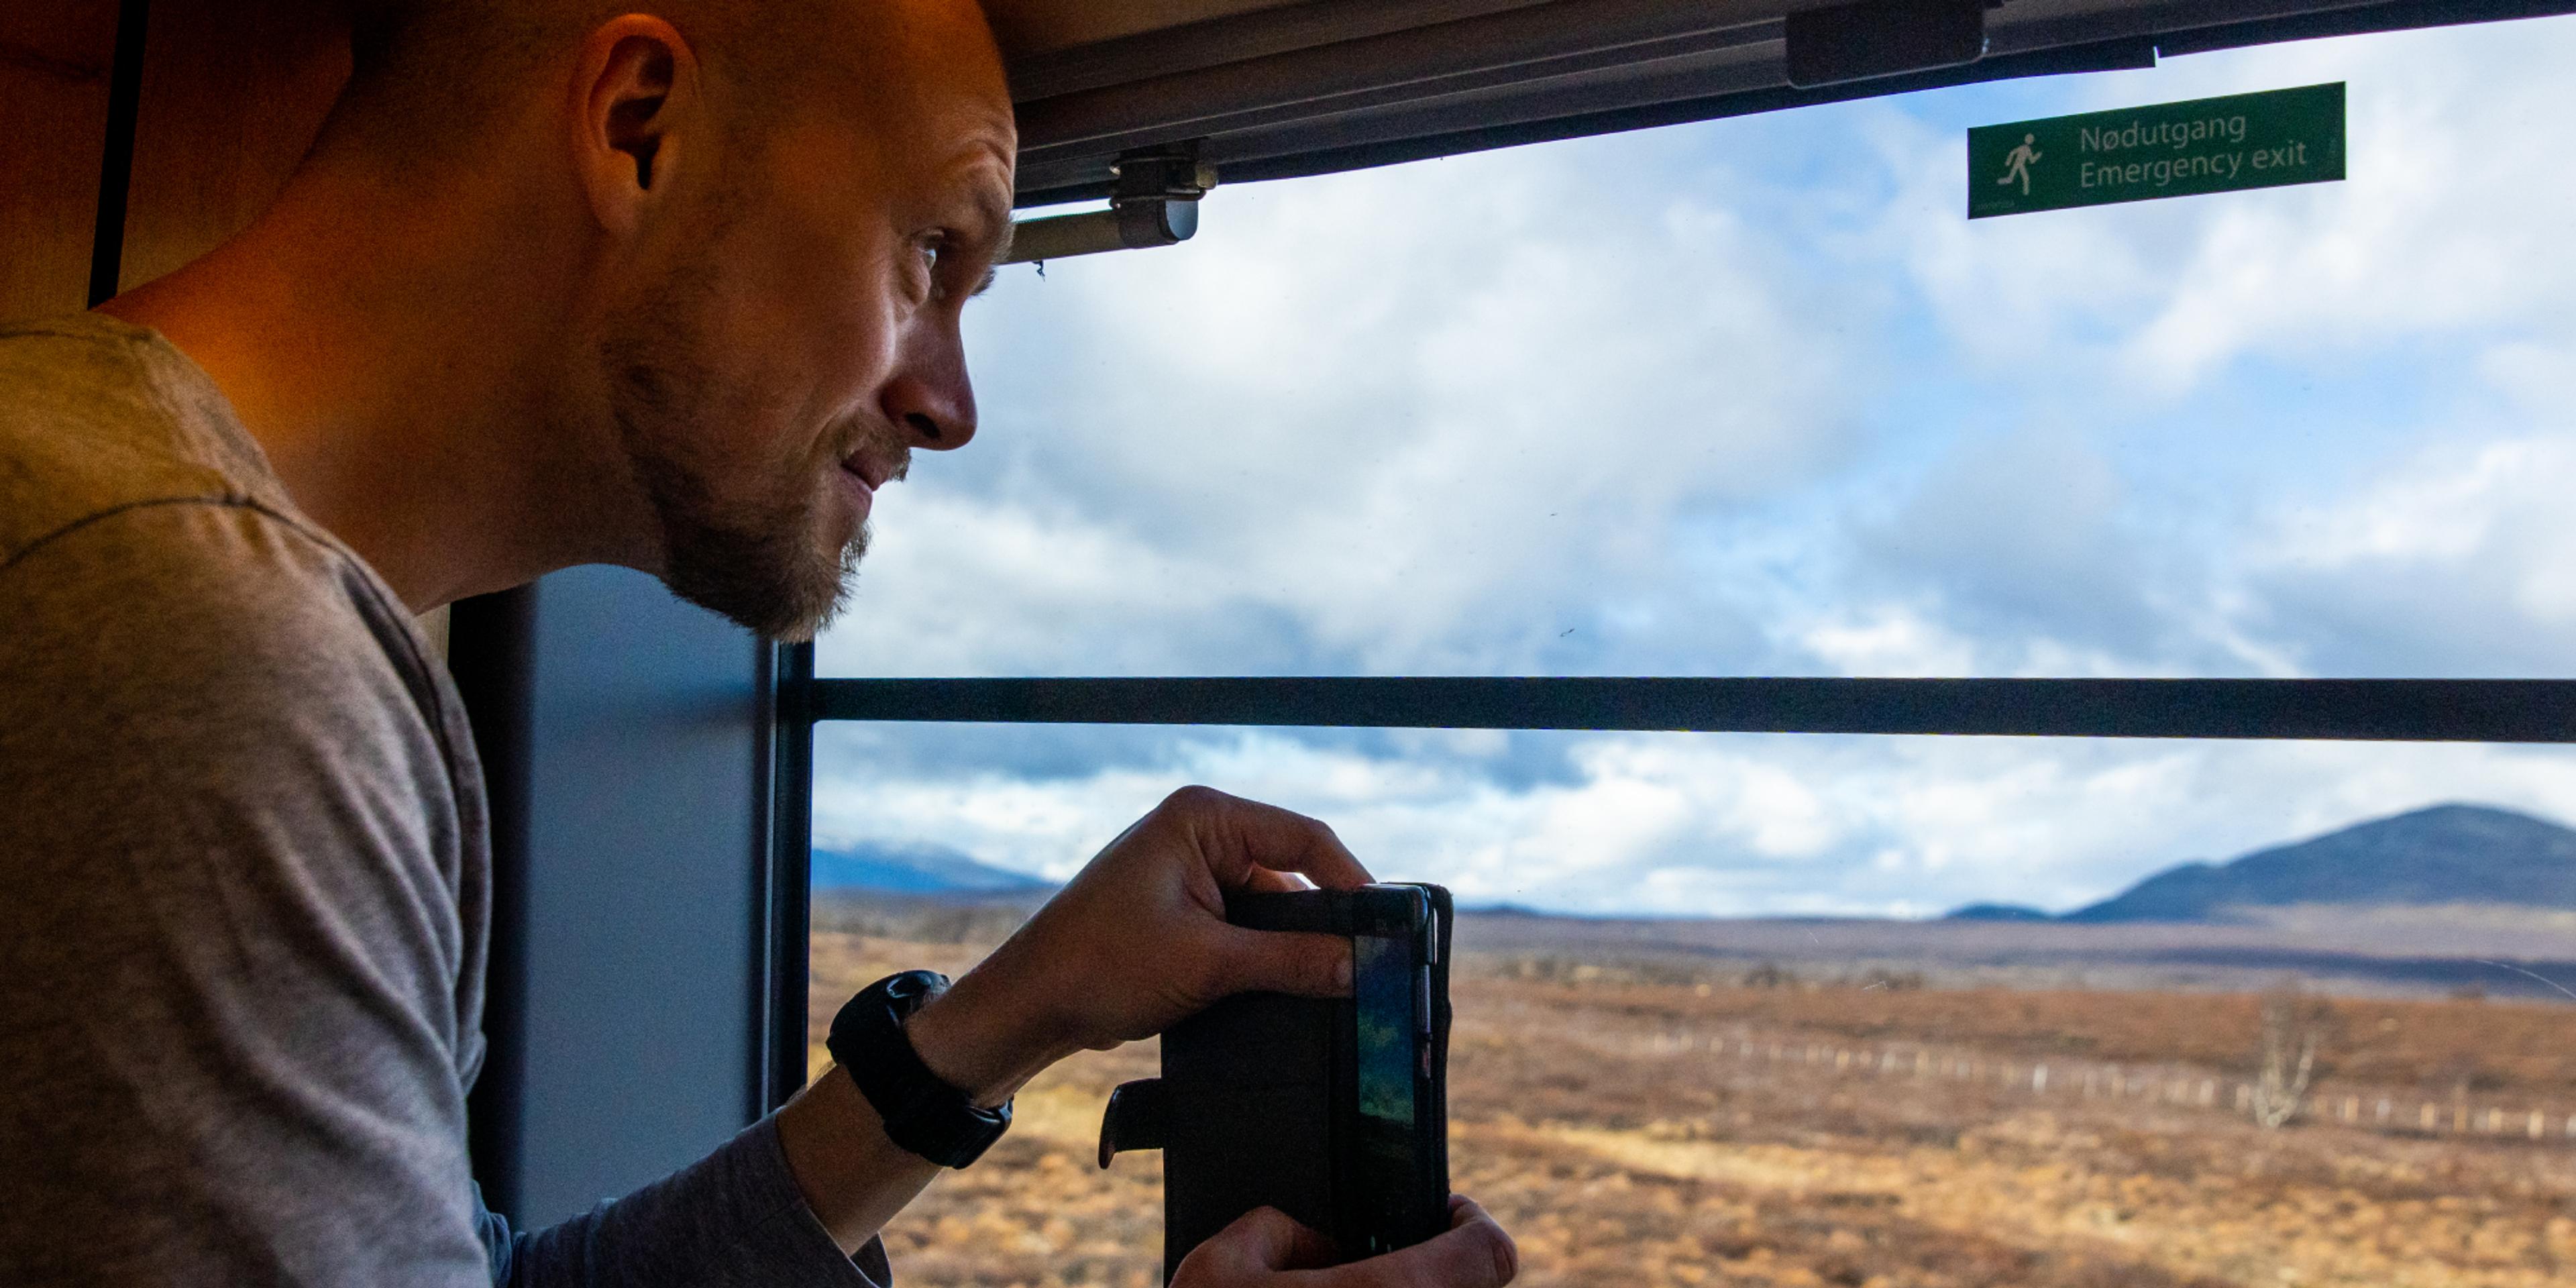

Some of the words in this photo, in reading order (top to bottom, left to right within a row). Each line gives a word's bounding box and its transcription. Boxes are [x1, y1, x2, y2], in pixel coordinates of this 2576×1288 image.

[2081, 115, 2246, 151] Nødutgang
[2080, 152, 2242, 188] Emergency
[2252, 142, 2307, 169] exit
